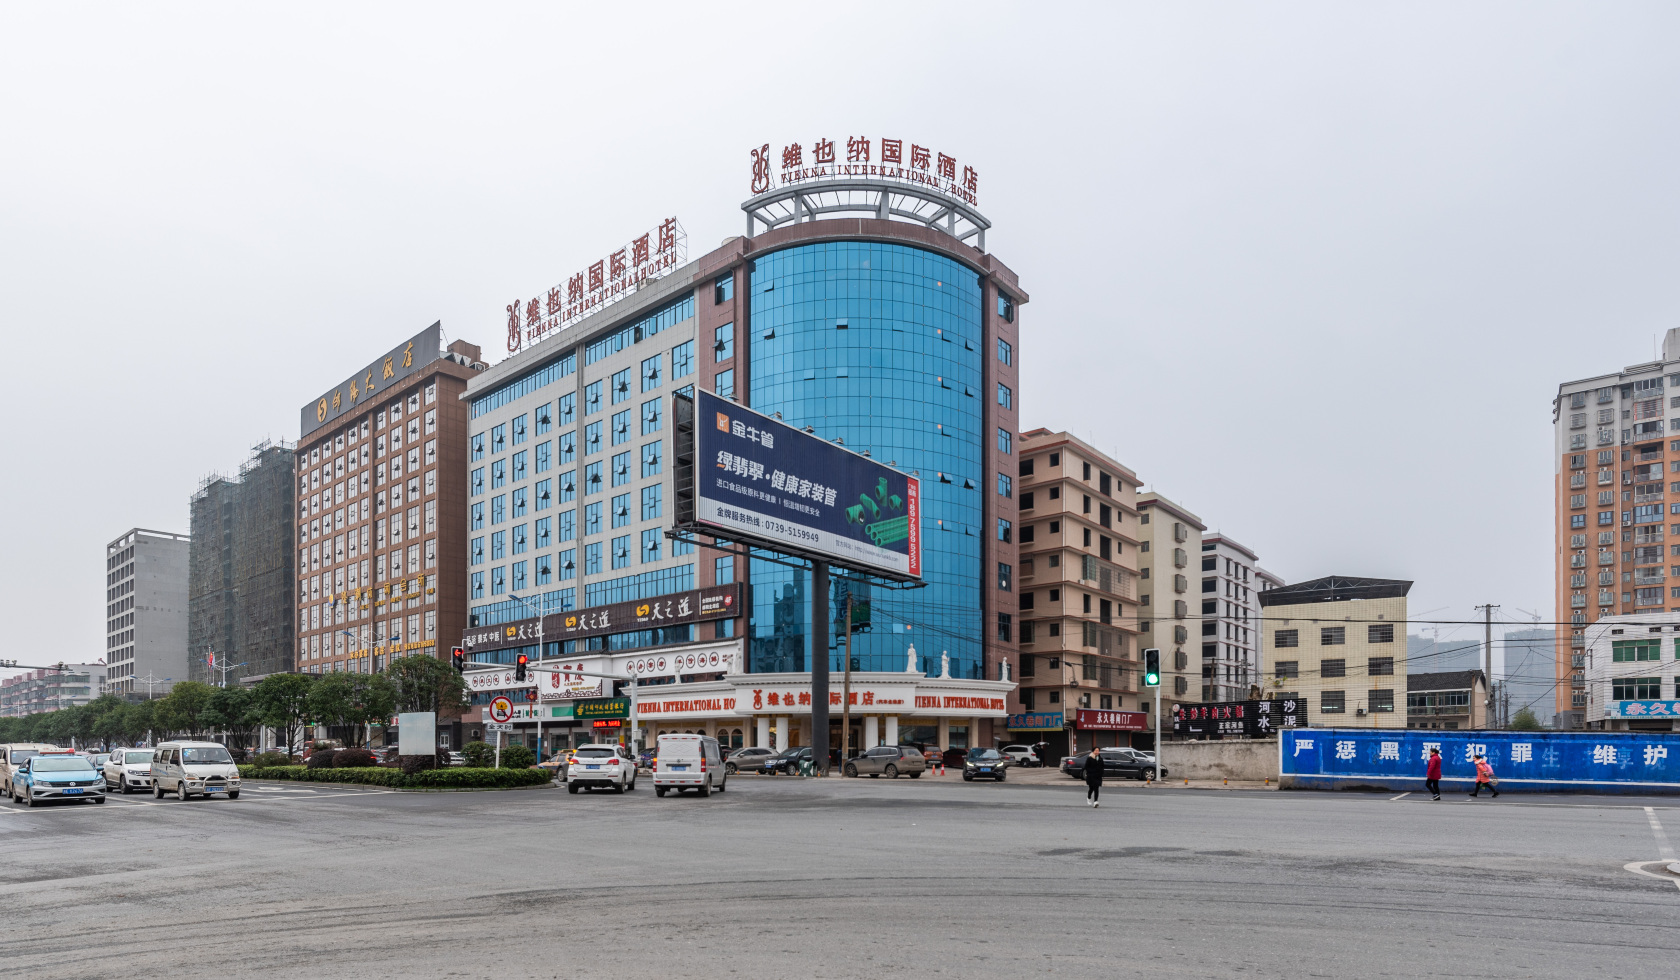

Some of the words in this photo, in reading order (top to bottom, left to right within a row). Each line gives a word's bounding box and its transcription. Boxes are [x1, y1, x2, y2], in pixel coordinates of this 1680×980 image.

[781, 136, 978, 193] 维也纳国际酒店
[781, 166, 827, 184] VIENNA
[837, 164, 939, 188] INTERNATIONAL
[951, 184, 978, 206] HOTEL
[526, 218, 676, 328] 维也纳国际酒店
[527, 319, 559, 341] VIENNA
[562, 275, 639, 322] INTERNATIONAL
[640, 252, 677, 280] HOTEL
[732, 419, 774, 449] 金牛管
[651, 597, 692, 620] 天之道
[578, 610, 611, 631] 天之道
[637, 702, 661, 713] VIENNA
[663, 699, 721, 713] INTERNATIONAL
[767, 690, 875, 706] 维也纳际酒店
[914, 695, 941, 709] VIENNA
[943, 696, 990, 710] INTERNATIONAL
[990, 698, 1005, 710] HOTEL
[1008, 714, 1062, 728] 永久卷闸门厂
[1096, 712, 1132, 724] 永久卷闸门厂
[1179, 704, 1244, 720] 生炒羊肉火锅
